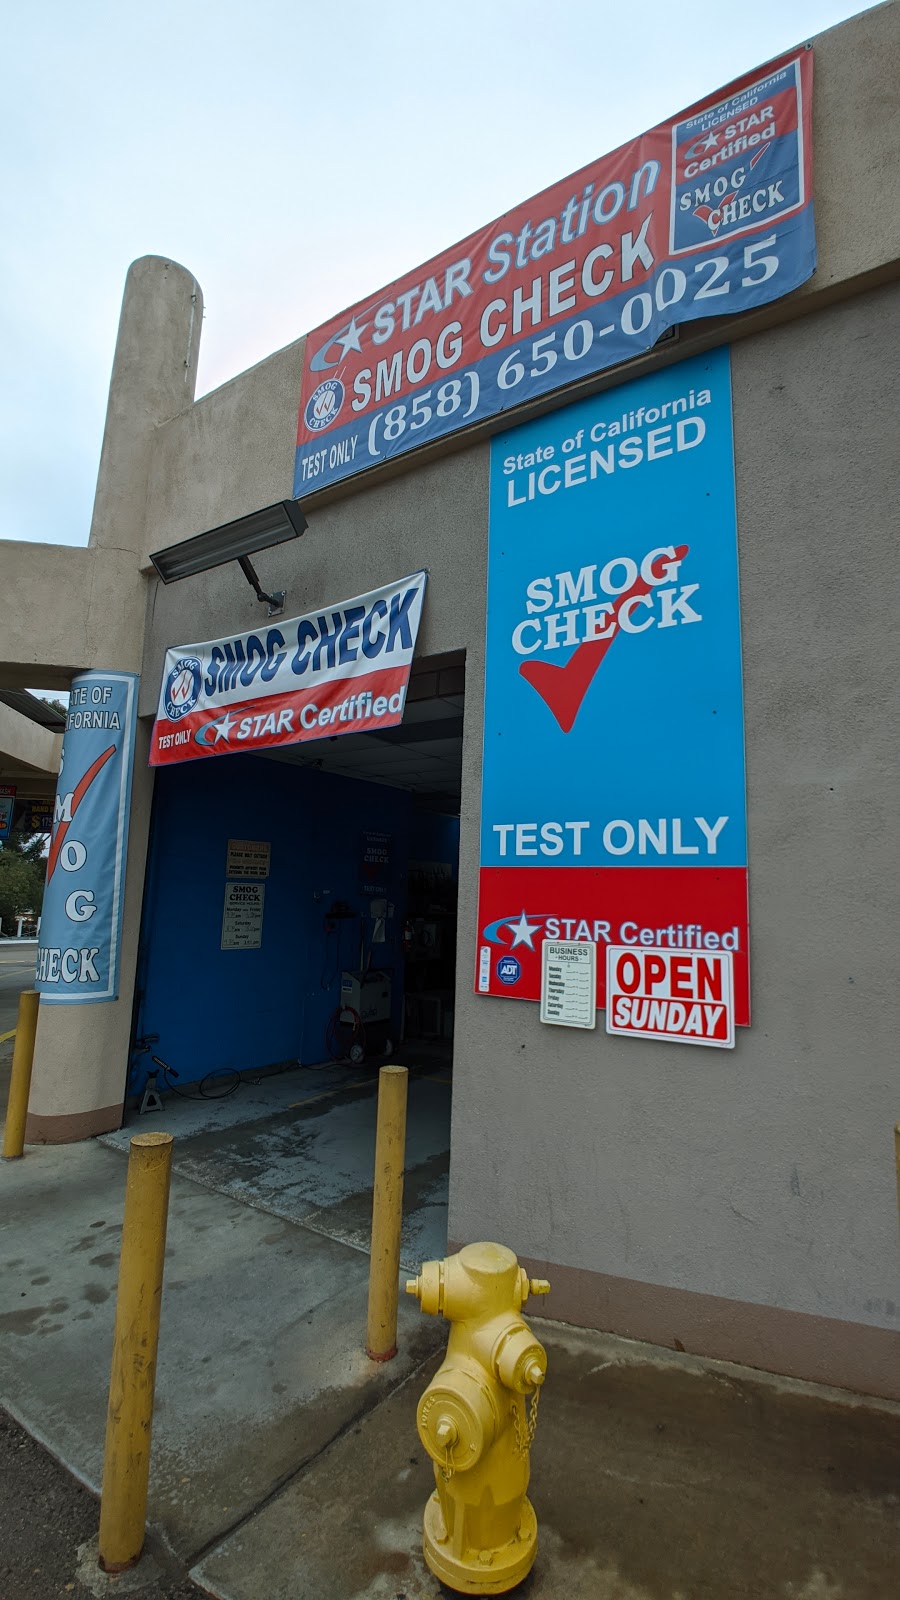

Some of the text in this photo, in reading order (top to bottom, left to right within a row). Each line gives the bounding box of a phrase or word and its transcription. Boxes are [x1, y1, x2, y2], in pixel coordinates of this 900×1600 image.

[685, 72, 787, 129] State of California
[701, 97, 758, 131] LICENSED
[724, 106, 775, 140] STAR
[684, 122, 776, 178] Certified
[680, 167, 746, 211] SMOG
[707, 180, 785, 231] CHECK
[372, 158, 661, 346] STAR Station
[350, 213, 656, 412] SMOG CHECK
[366, 234, 779, 457] (858) 650-0025
[312, 382, 338, 401] SMOG
[309, 407, 339, 428] CHECK
[502, 388, 713, 476] State of California
[302, 434, 358, 481] TEST ONLY
[506, 415, 707, 508] LICENSED
[525, 545, 682, 615] SMOG
[511, 583, 703, 655] CHECK
[204, 587, 419, 697] SMOG CHECK
[172, 660, 198, 678] SMOG
[91, 686, 112, 704] OF
[166, 696, 197, 717] CHECK
[236, 686, 405, 741] STAR Certified
[158, 729, 192, 749] TEST ONLY
[493, 816, 729, 856] TEST ONLY
[545, 918, 740, 951] STAR Certified
[549, 946, 588, 956] BUSINESS
[501, 964, 517, 975] ADT
[616, 952, 722, 1001] OPEN
[614, 997, 725, 1037] SUNDAY
